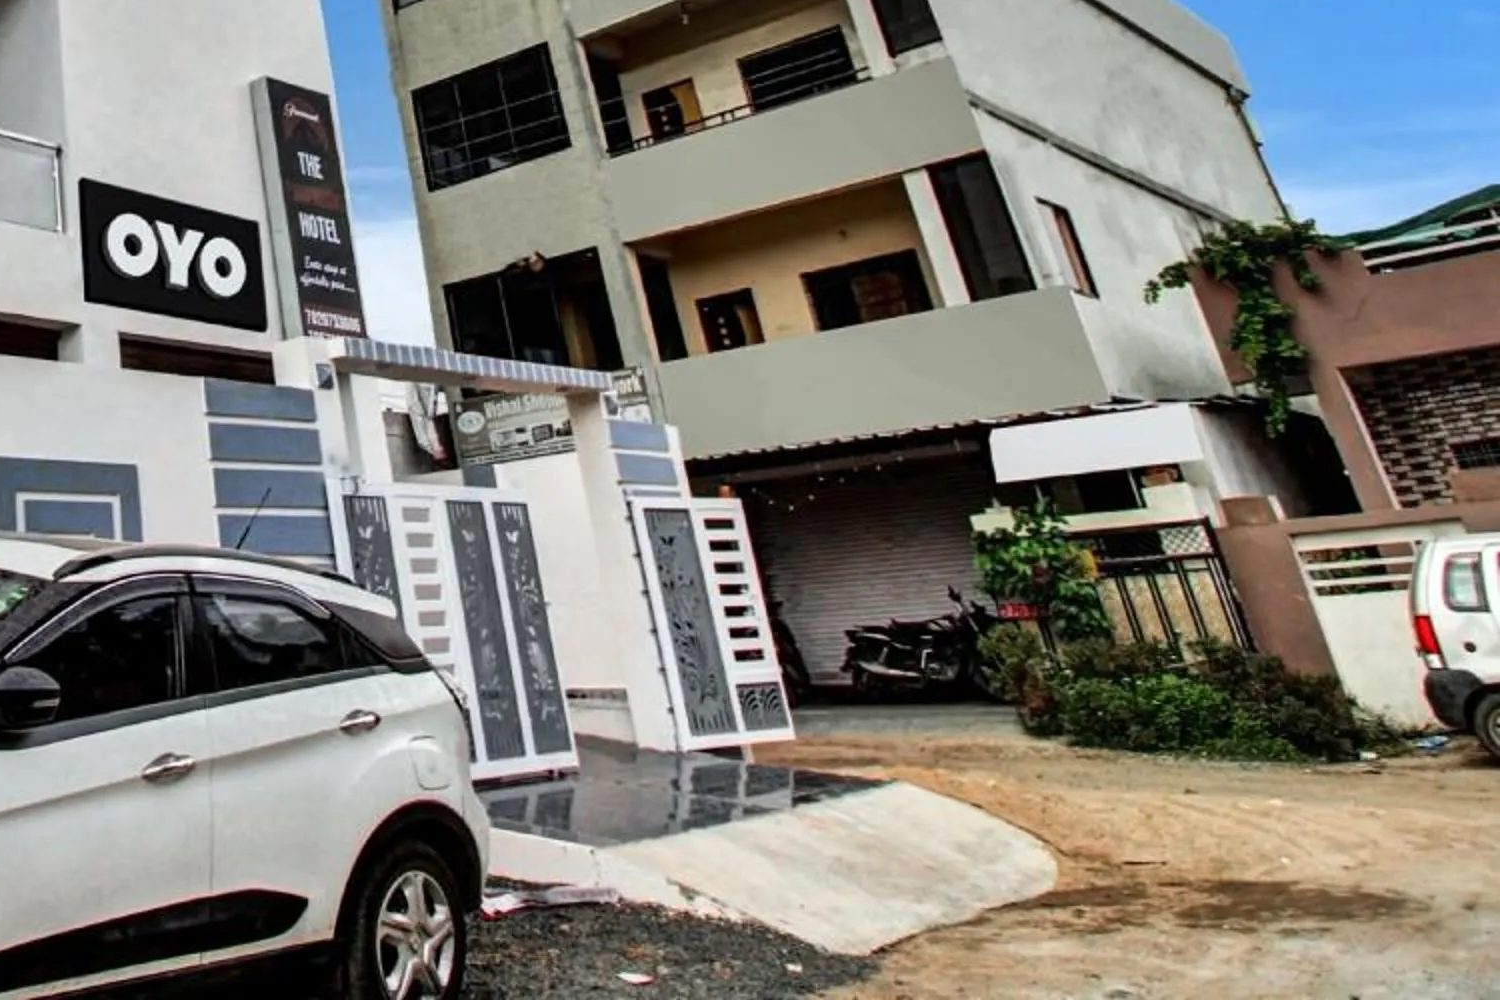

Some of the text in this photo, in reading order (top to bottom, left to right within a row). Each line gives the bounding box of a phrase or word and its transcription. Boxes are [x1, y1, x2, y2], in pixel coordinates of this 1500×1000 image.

[297, 151, 324, 180] THE
[299, 210, 341, 245] HOTEL
[104, 212, 248, 299] OYO
